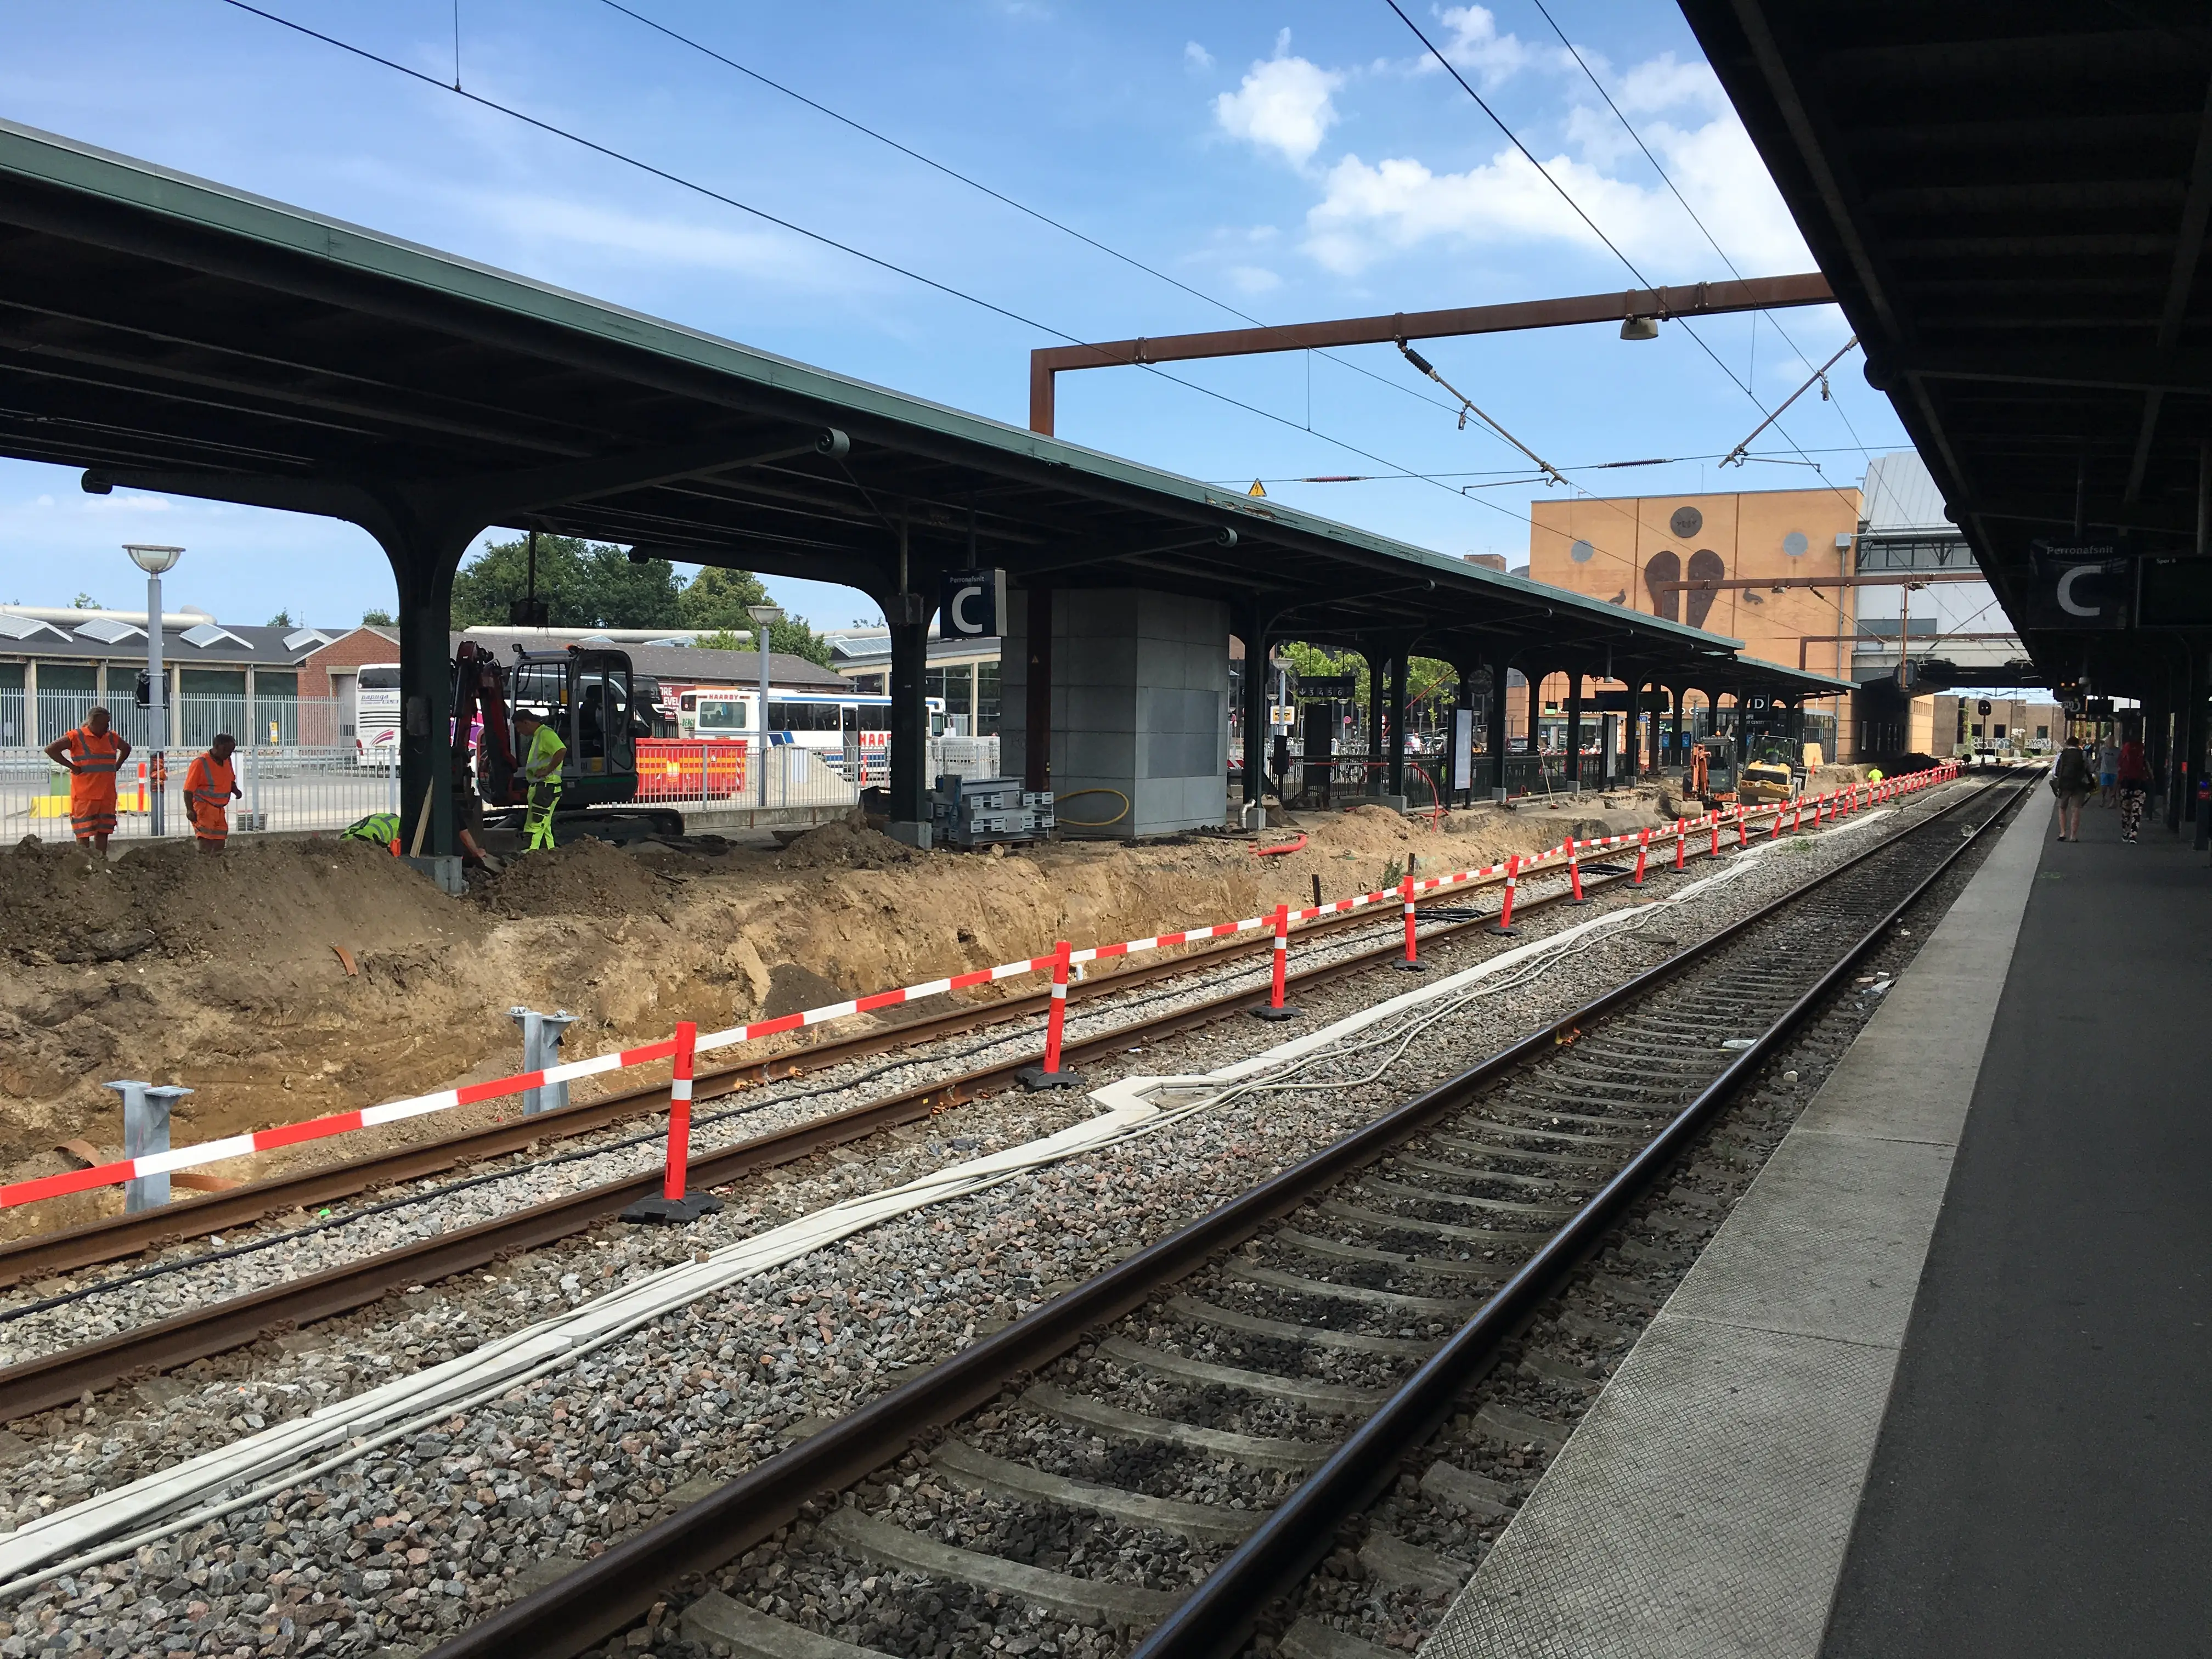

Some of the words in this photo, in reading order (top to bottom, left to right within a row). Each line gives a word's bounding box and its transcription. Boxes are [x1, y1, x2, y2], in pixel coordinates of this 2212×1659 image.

[2047, 546, 2113, 555] Perronafsnit
[2057, 565, 2102, 617] C
[952, 586, 983, 634] C
[1754, 698, 1764, 709] D
